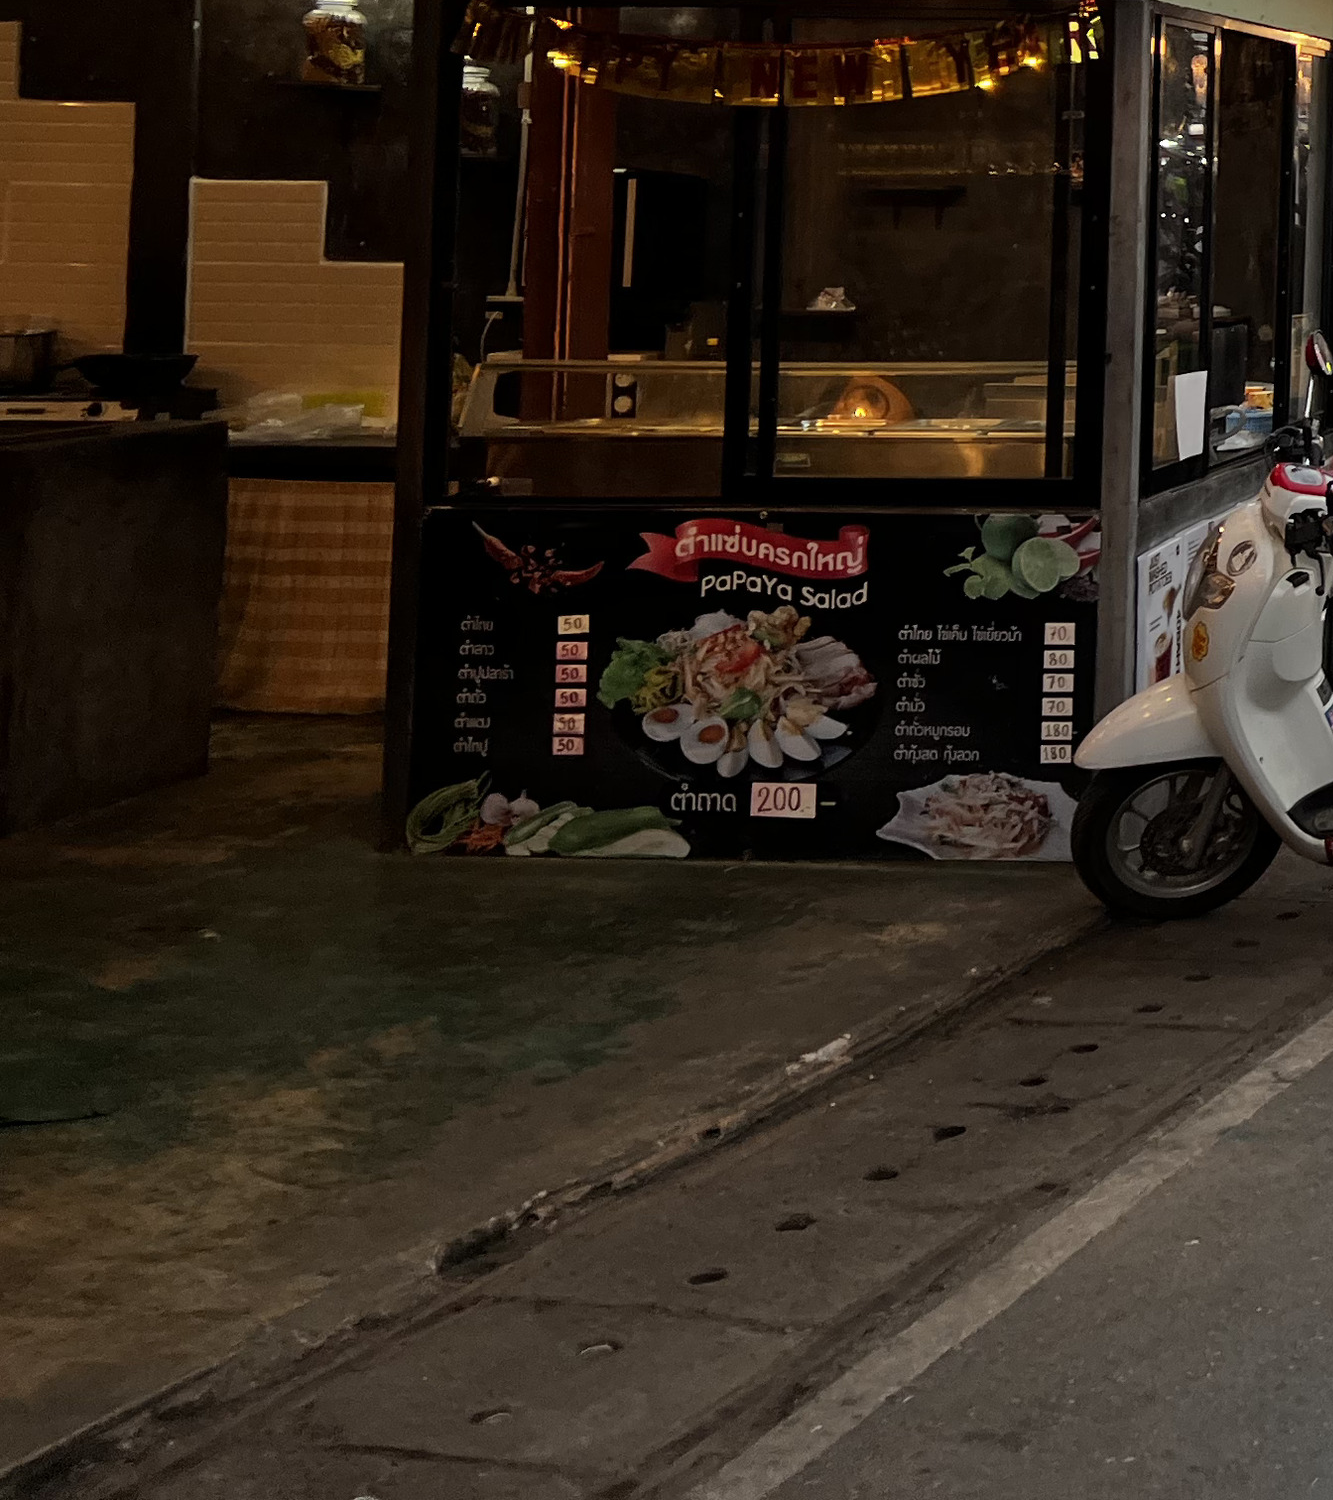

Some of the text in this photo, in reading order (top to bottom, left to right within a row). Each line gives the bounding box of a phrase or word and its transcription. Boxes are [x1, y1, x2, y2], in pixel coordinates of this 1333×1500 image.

[674, 524, 864, 574] ตำแซ่บครกใหญ่
[799, 580, 869, 610] Salad
[898, 623, 933, 642] ตำไทย
[897, 648, 942, 665] ตำผลไม้
[1046, 674, 1066, 689] 70
[670, 782, 737, 812] ตำถาด
